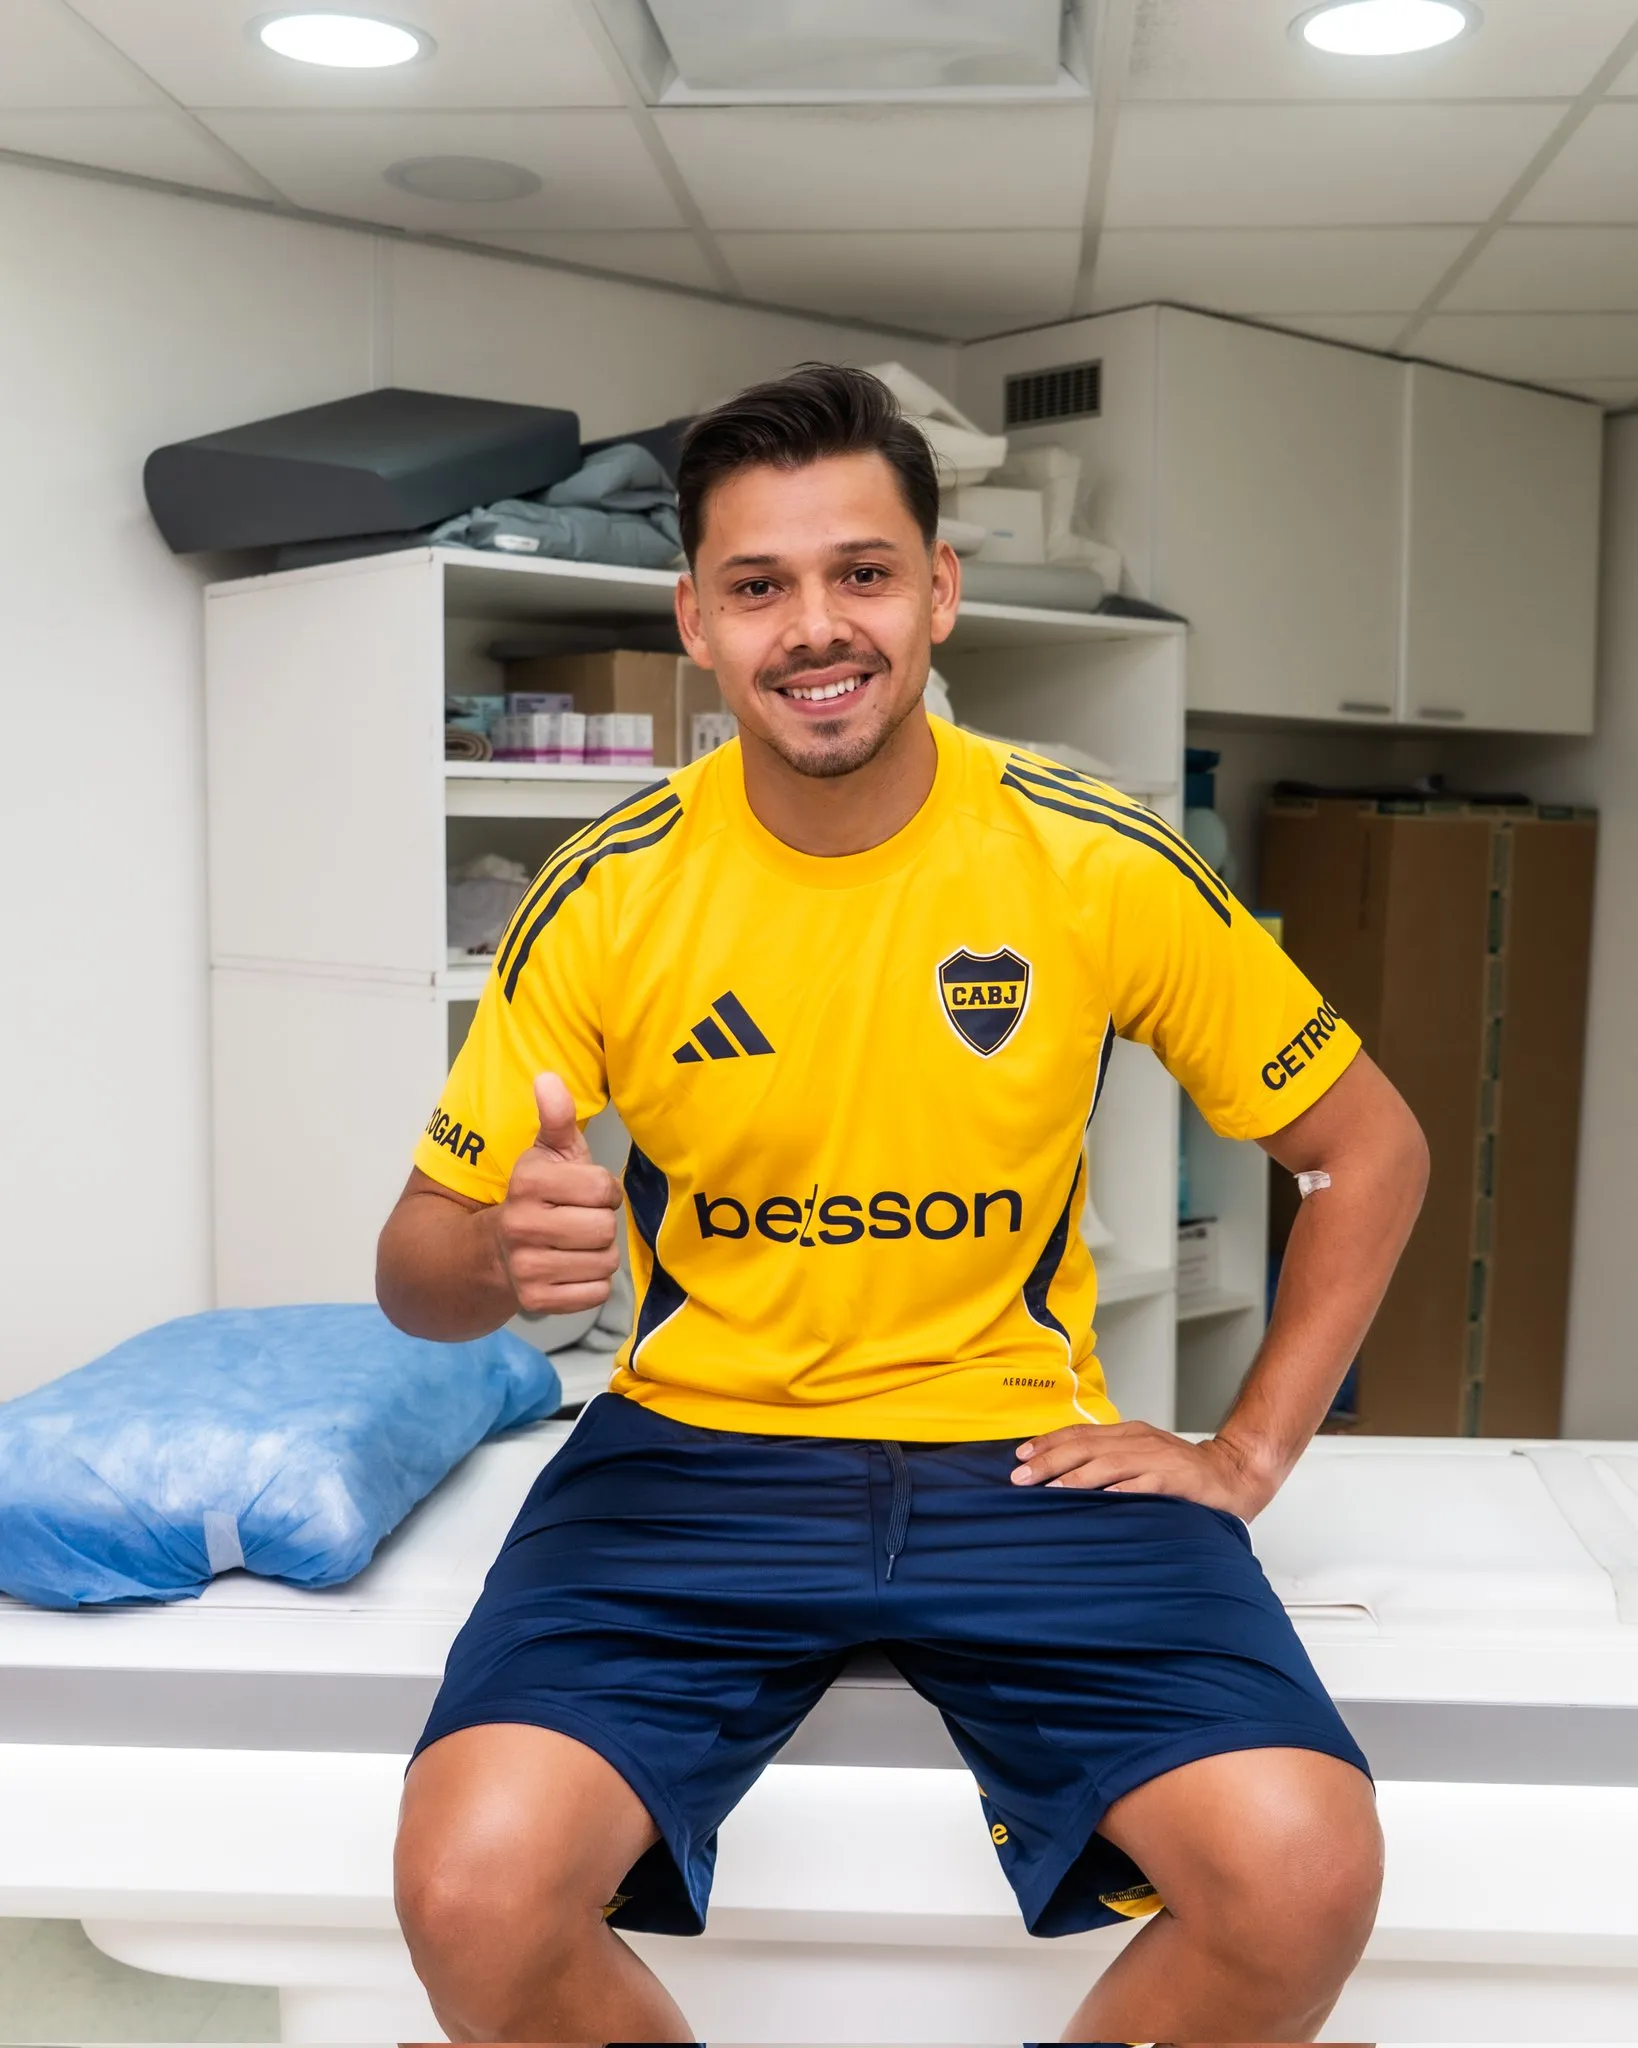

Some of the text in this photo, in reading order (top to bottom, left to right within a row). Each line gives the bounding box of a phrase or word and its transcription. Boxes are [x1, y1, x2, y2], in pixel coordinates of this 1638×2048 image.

[952, 985, 1017, 1006] CABJ
[425, 1105, 485, 1167] OGAR
[693, 1183, 1023, 1248] betsson
[1003, 1377, 1056, 1389] AEROREADY
